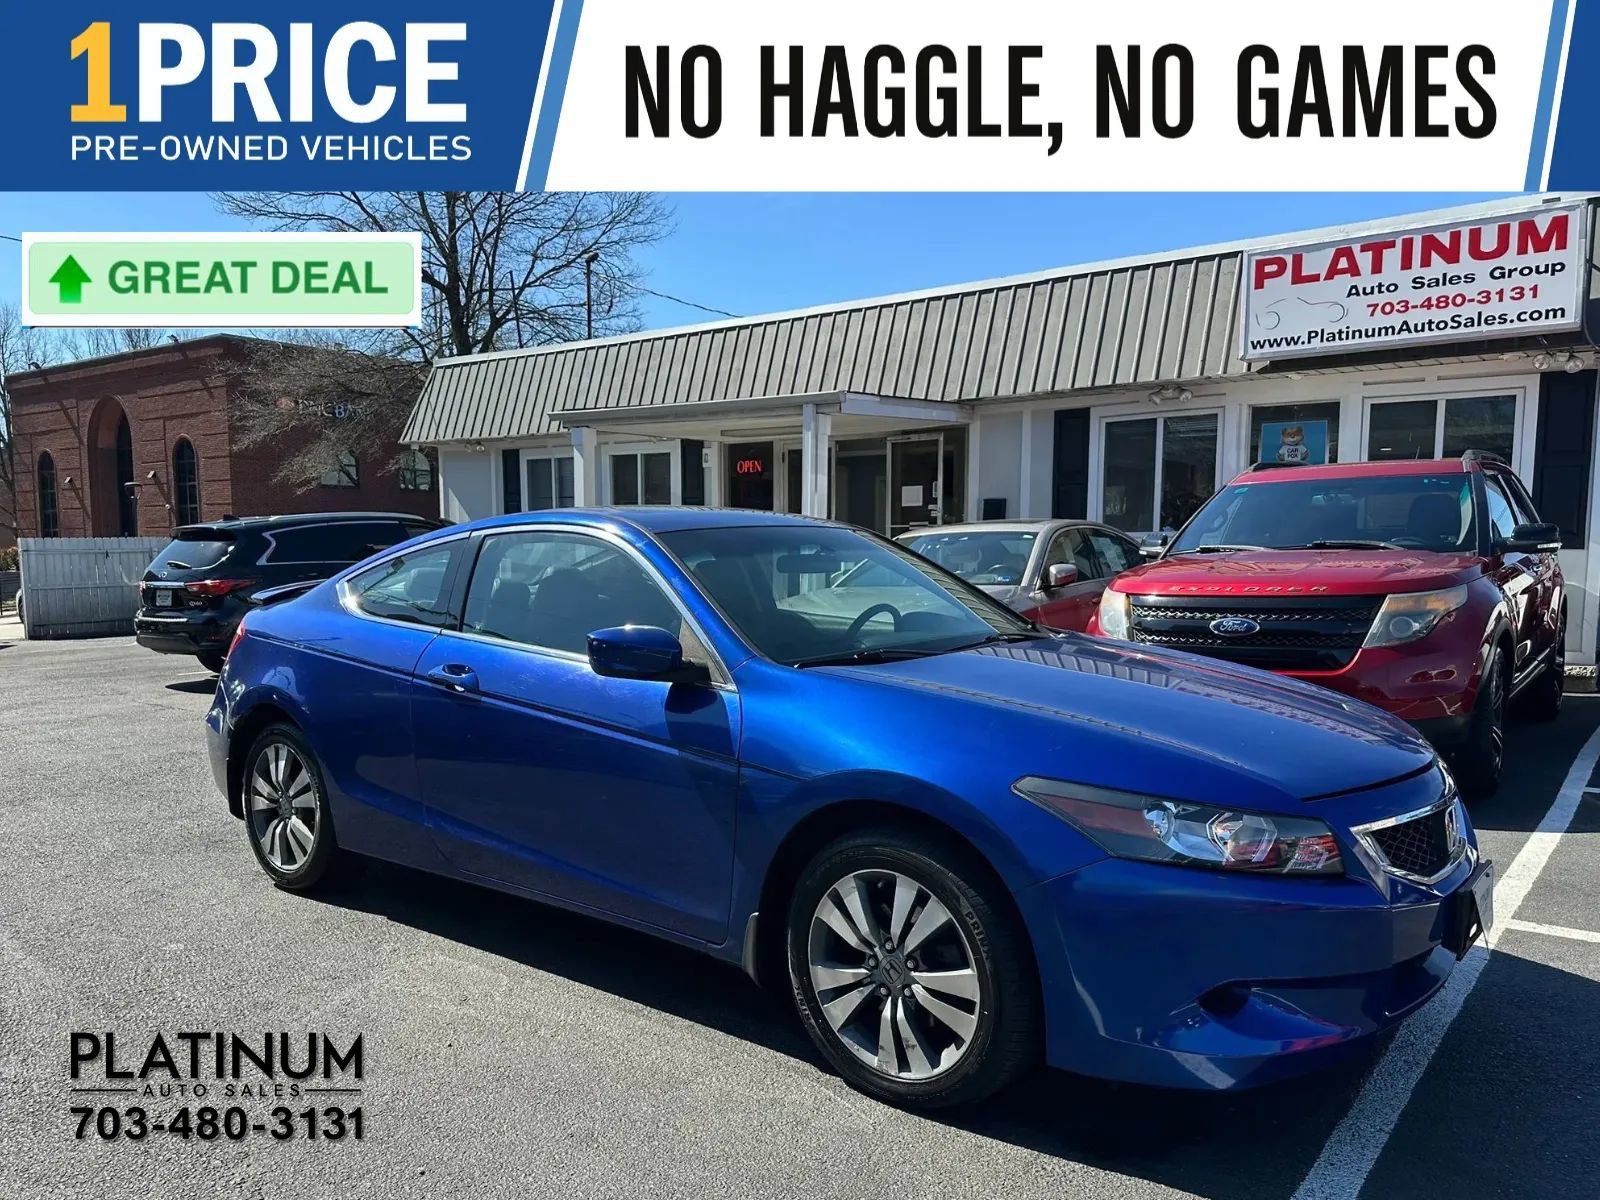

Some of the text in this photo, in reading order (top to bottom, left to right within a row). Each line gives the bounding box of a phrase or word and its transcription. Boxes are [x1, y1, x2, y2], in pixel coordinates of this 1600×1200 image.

[1254, 214, 1569, 290] PLATINUM
[1346, 260, 1566, 298] Auto Sales Group
[1367, 284, 1539, 317] 703-480-3131
[1251, 306, 1566, 350] www.PlatinumAutoSales.com
[737, 460, 762, 473] OPEN
[1218, 619, 1248, 633] Ford
